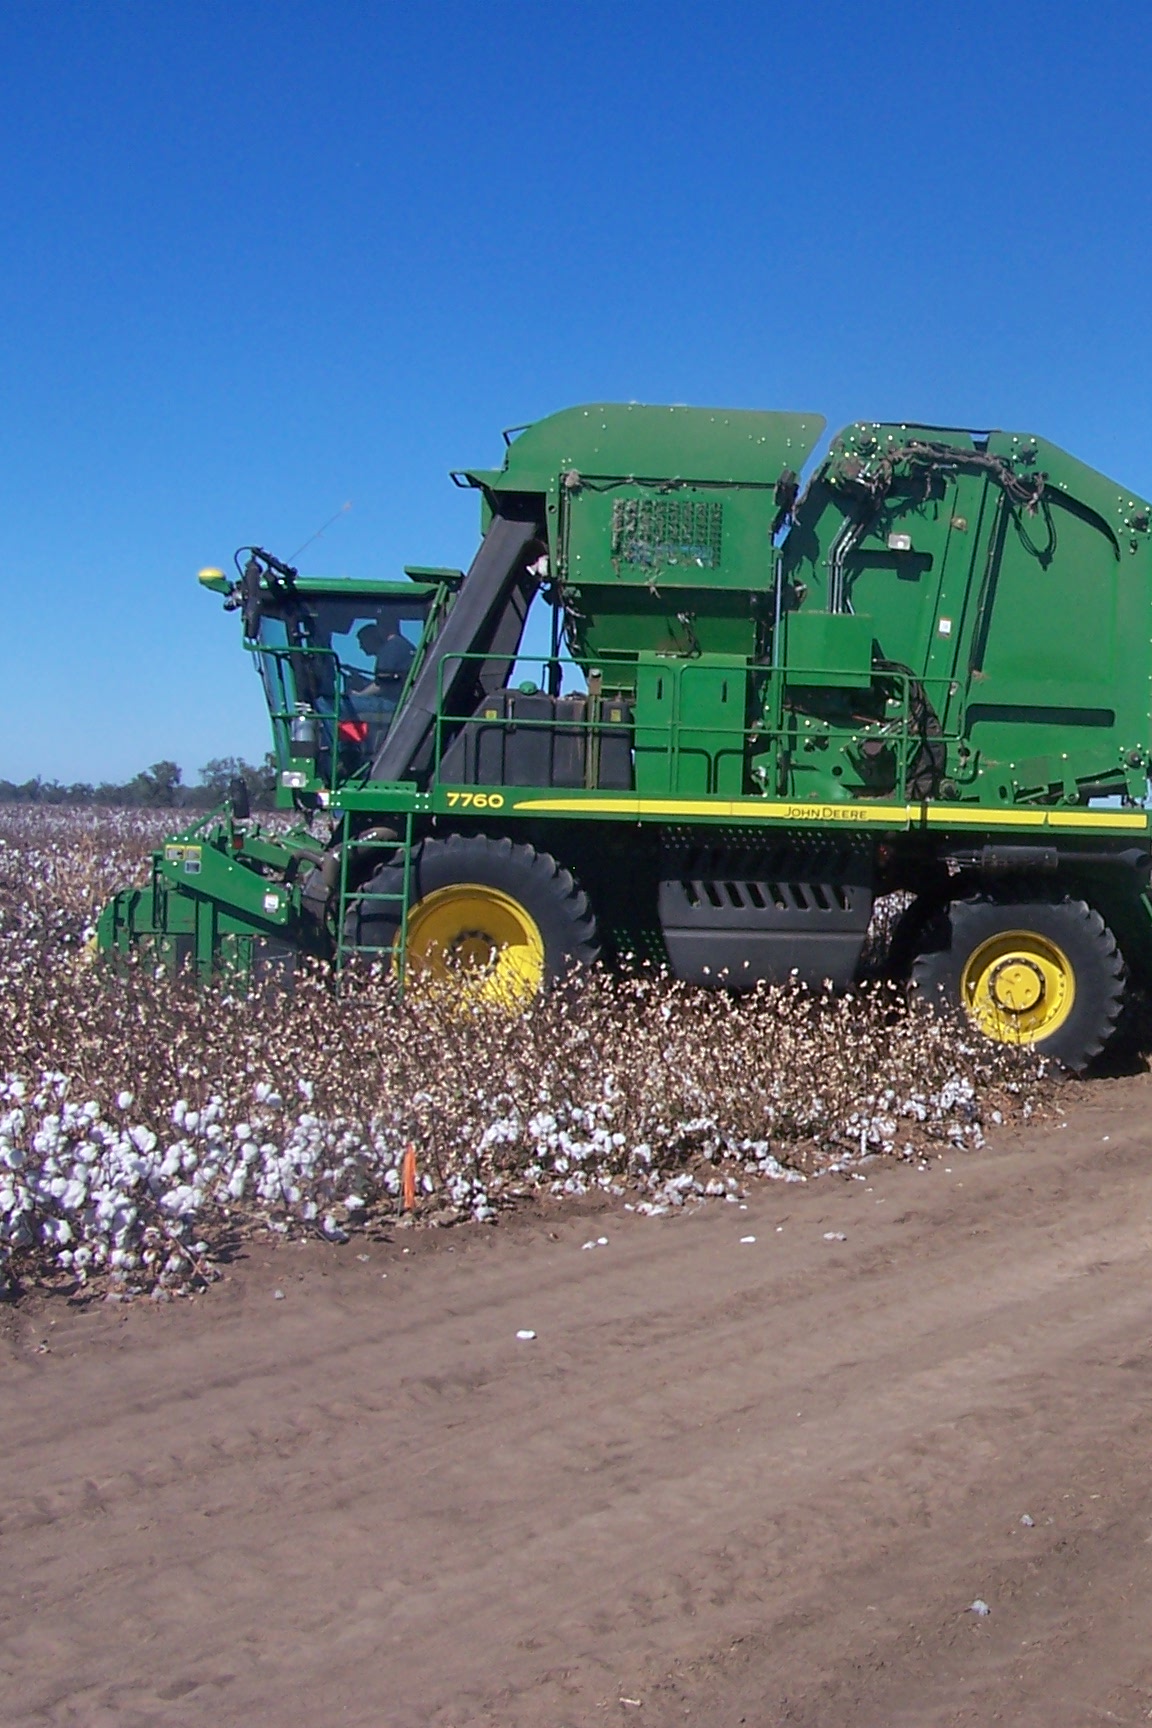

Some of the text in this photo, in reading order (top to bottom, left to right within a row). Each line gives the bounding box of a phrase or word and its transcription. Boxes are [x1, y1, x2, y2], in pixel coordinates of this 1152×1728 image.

[446, 792, 504, 808] 7760
[783, 806, 867, 819] JOHN DEERE
